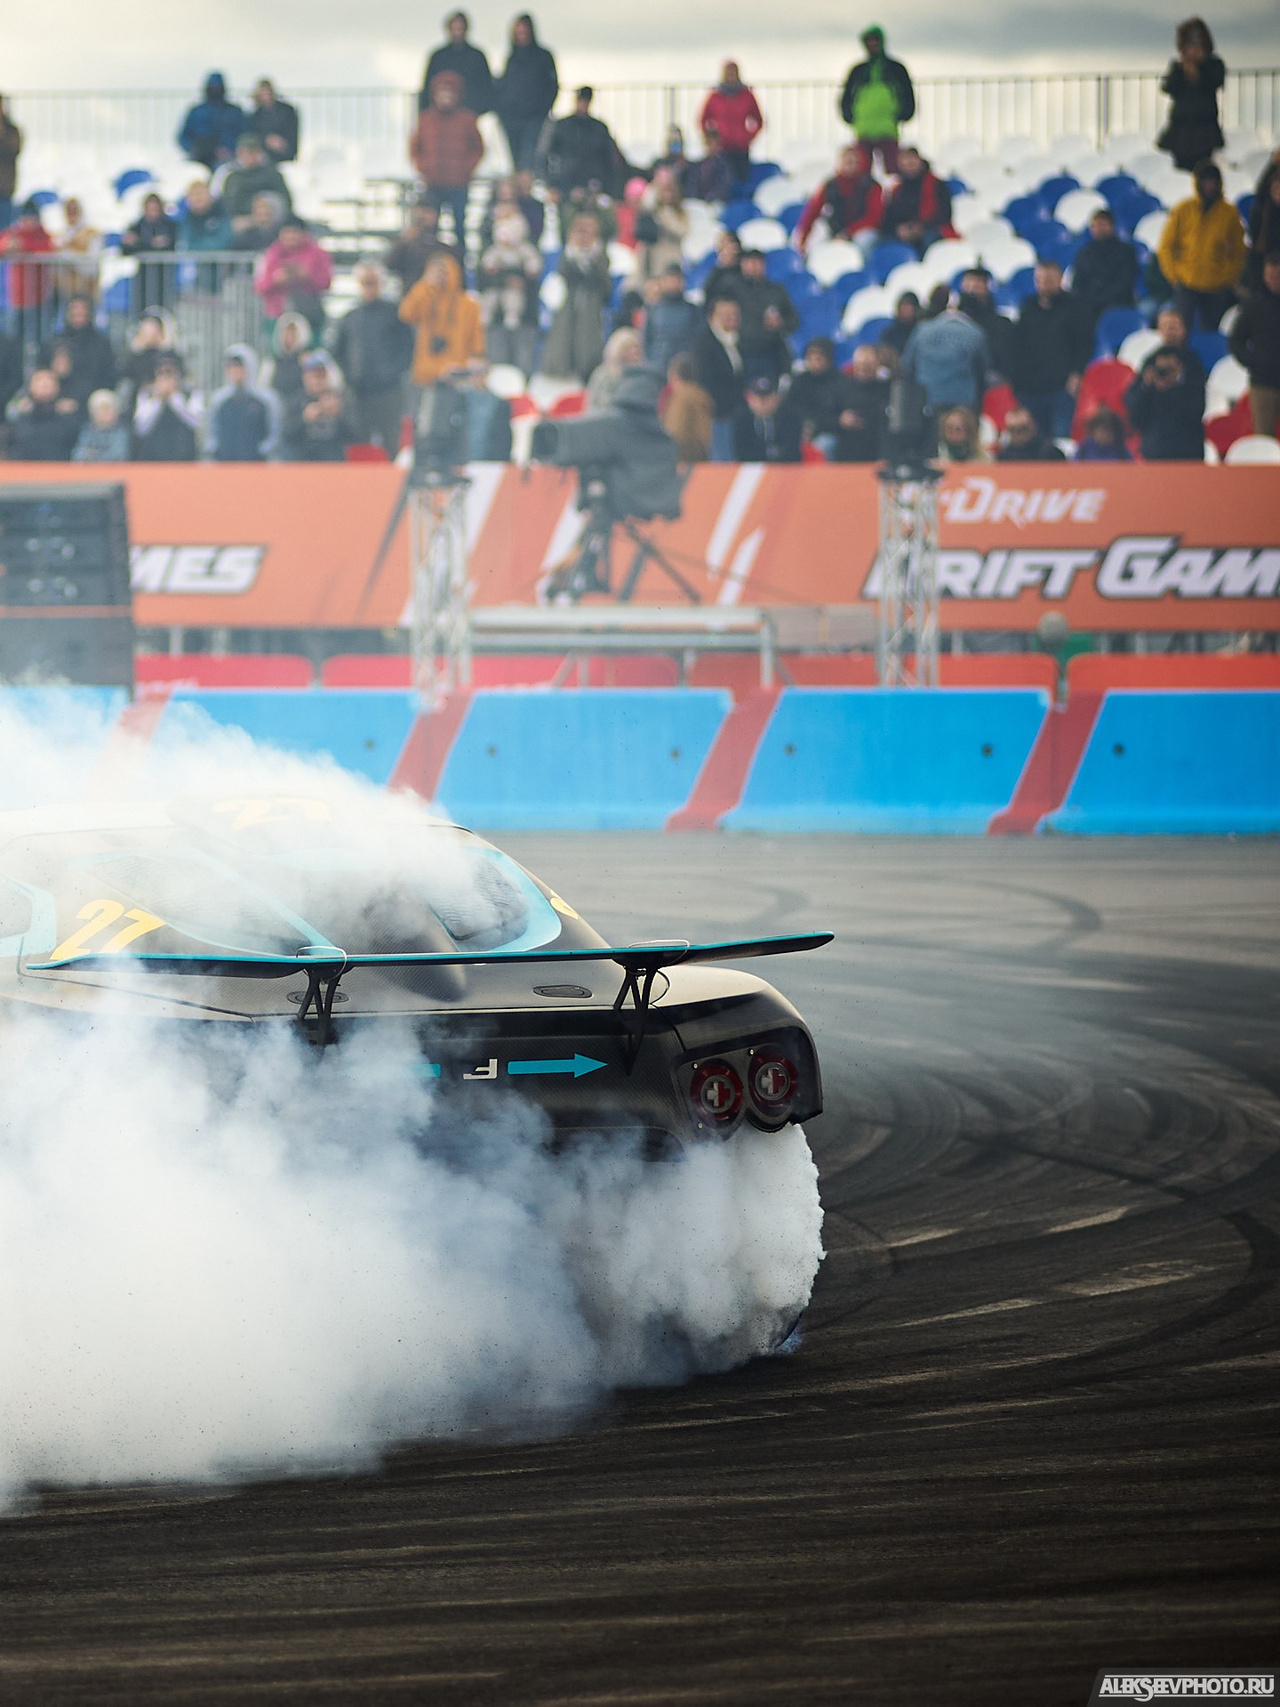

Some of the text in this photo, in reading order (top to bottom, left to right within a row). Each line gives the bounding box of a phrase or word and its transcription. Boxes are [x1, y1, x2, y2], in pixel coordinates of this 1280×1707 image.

[127, 545, 266, 593] MES
[1095, 535, 1280, 600] GAM
[49, 899, 166, 960] 27
